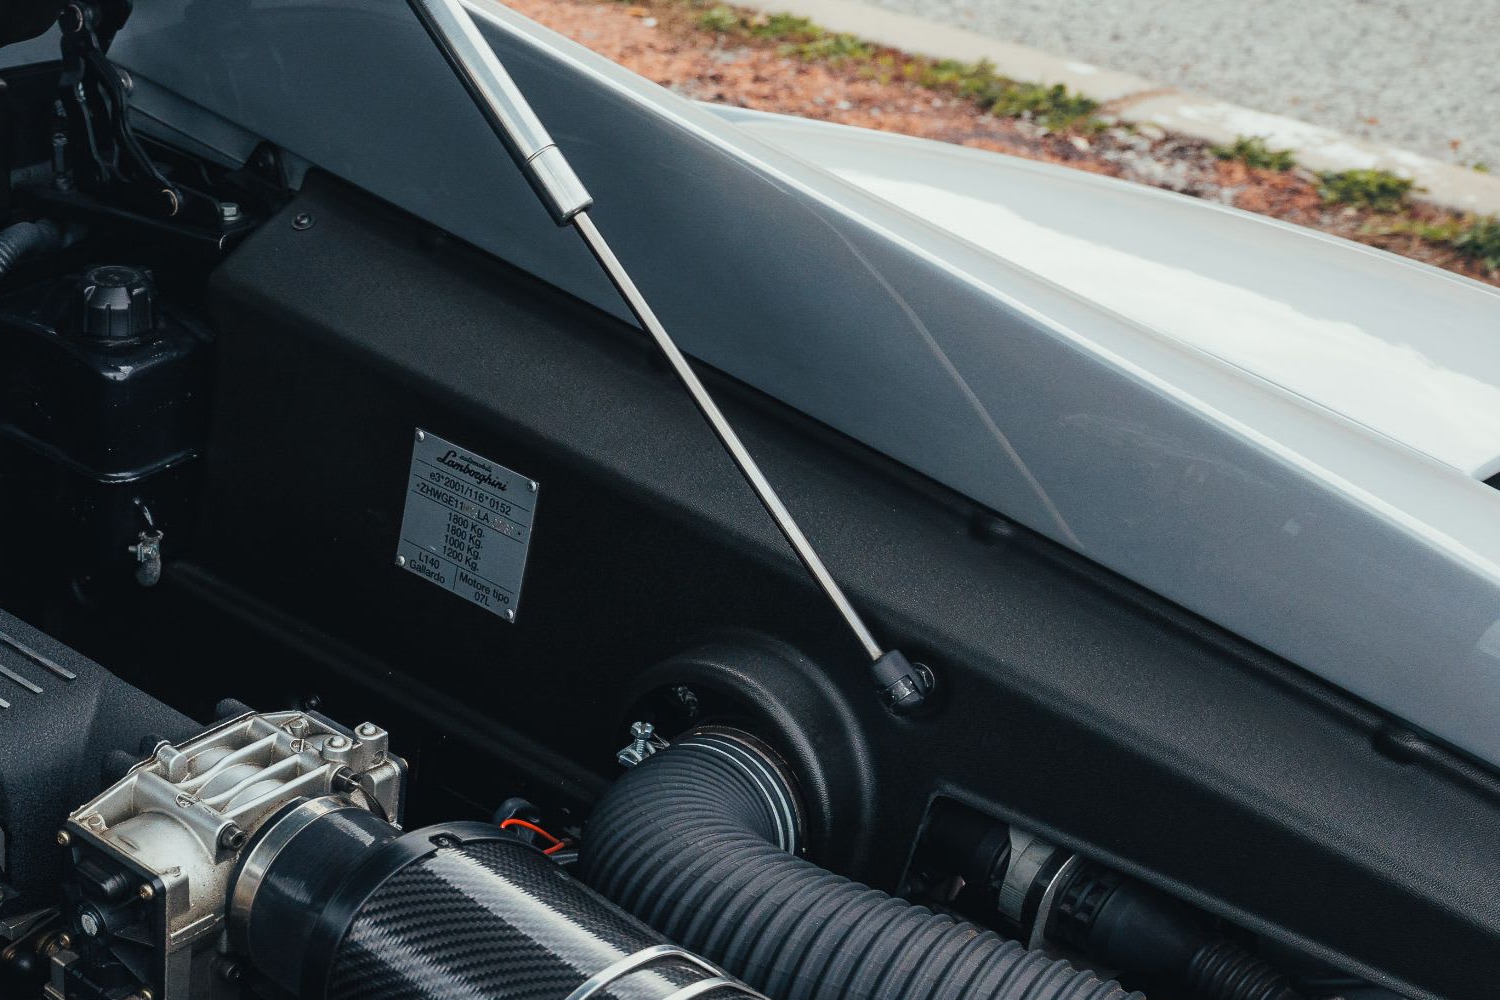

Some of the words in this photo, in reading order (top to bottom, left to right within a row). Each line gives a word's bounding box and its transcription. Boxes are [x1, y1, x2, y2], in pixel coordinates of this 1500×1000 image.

[436, 450, 509, 492] Lamborghini
[446, 523, 467, 541] 1800
[468, 533, 484, 550] Kg.
[448, 512, 469, 530] 1800
[470, 522, 485, 539] Kg.
[442, 545, 463, 562] 1200
[444, 534, 465, 552] 1000
[409, 559, 446, 584] Gallardo
[418, 552, 440, 570] L140
[459, 571, 491, 595] Motore
[492, 588, 510, 605] tipo
[474, 591, 490, 607] 07L
